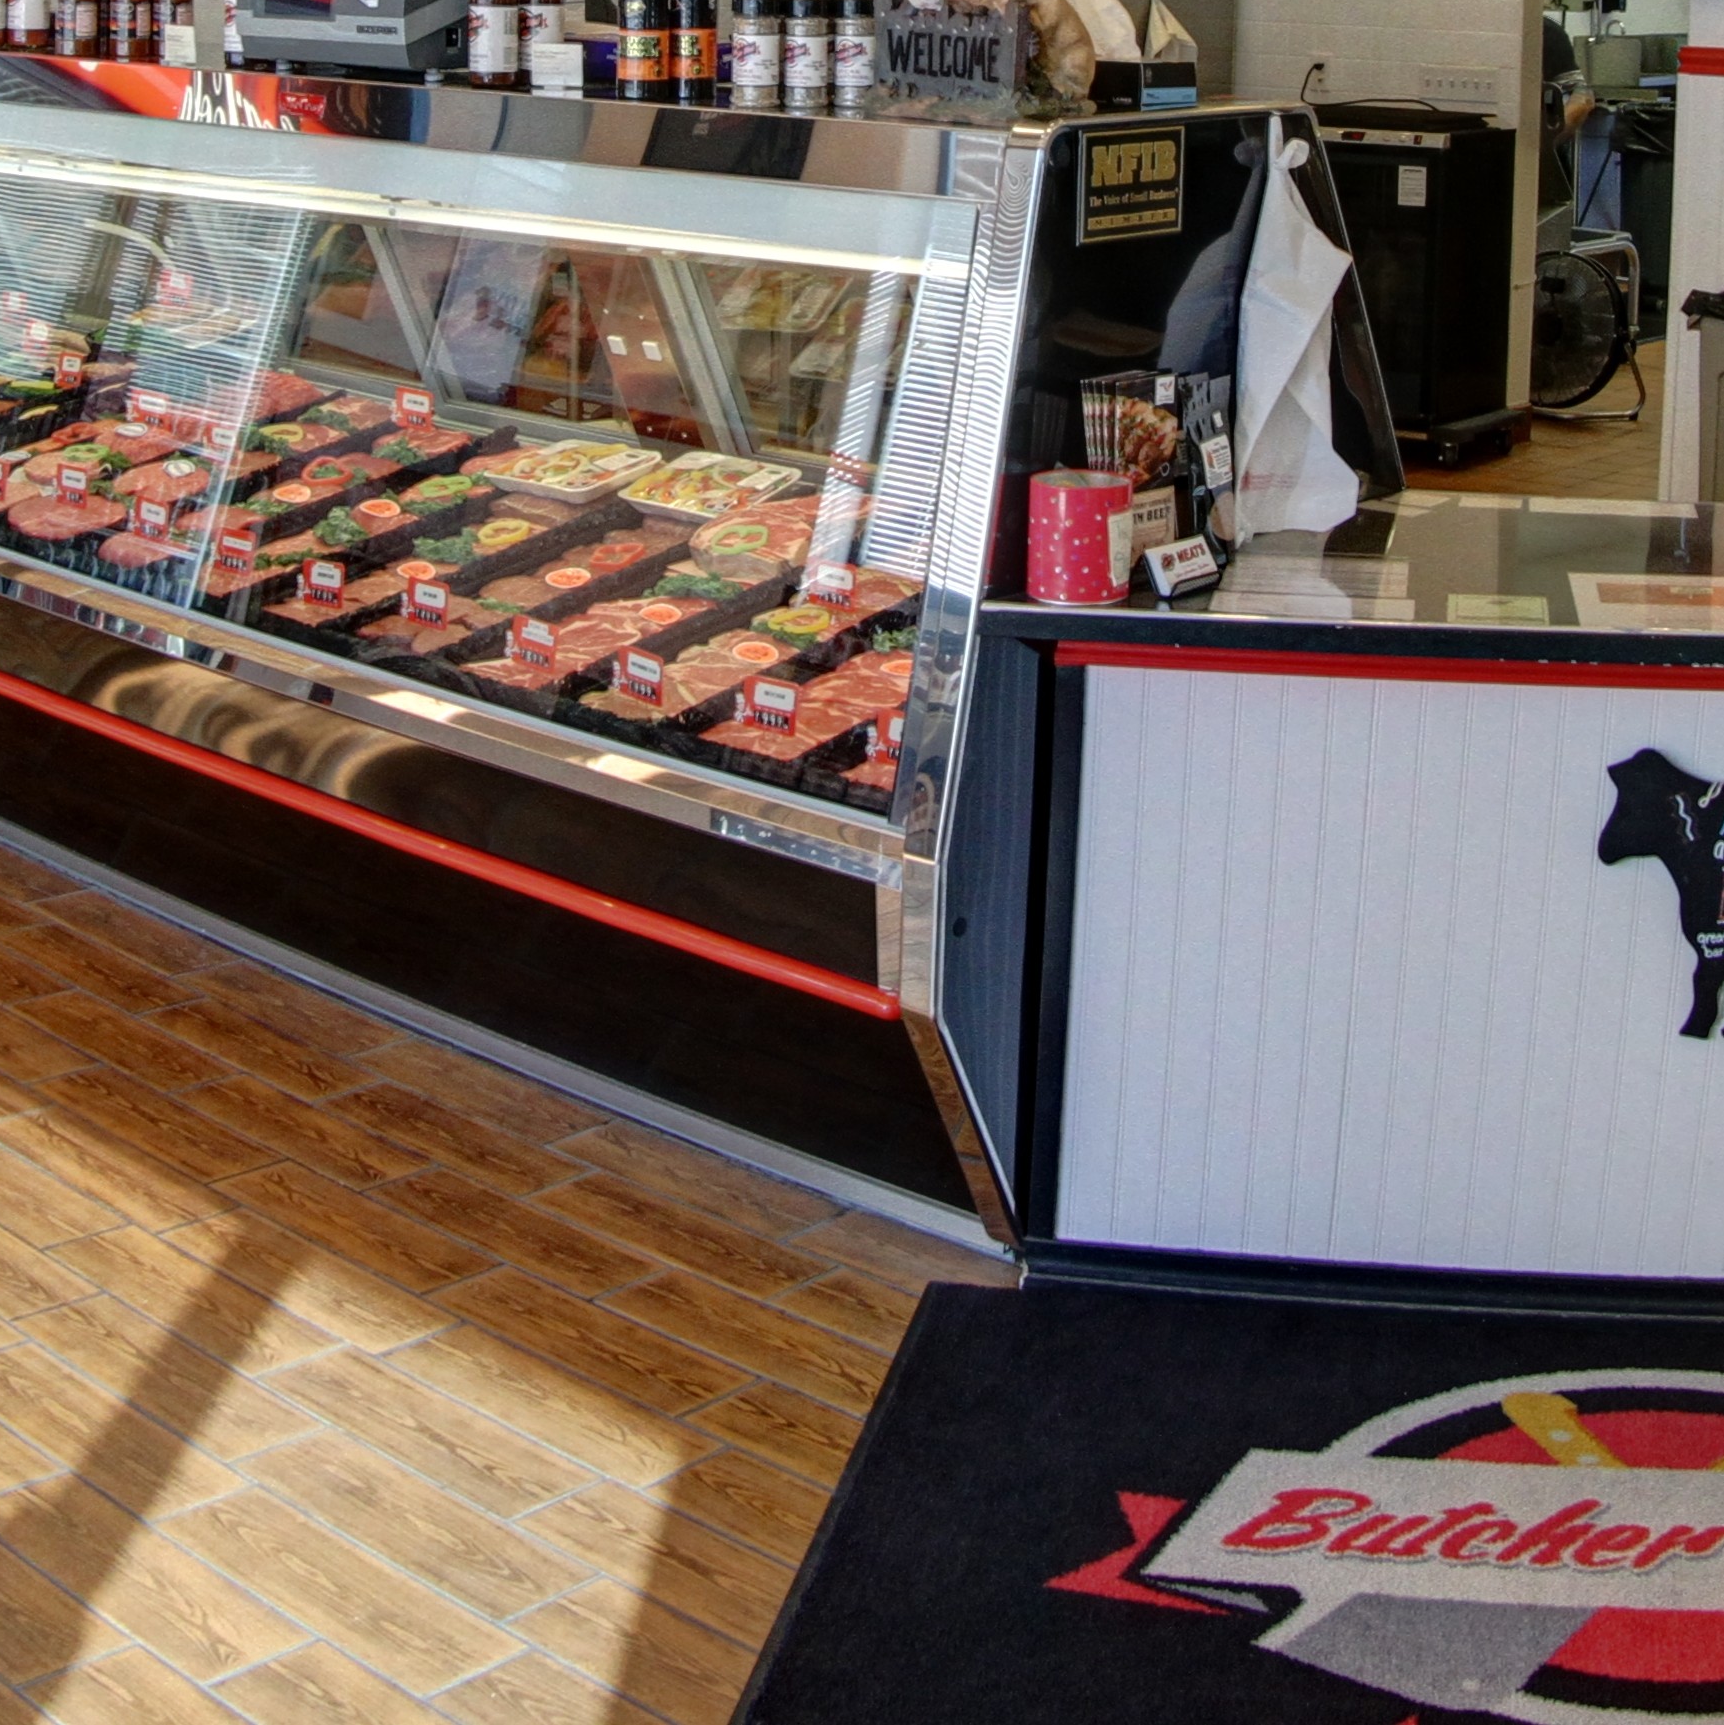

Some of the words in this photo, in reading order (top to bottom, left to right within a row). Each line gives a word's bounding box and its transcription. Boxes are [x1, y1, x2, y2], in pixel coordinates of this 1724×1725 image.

[887, 28, 1001, 83] WELCOME
[1091, 140, 1176, 187] NFIB
[1089, 196, 1102, 207] The
[1103, 194, 1120, 205] Voice
[1121, 193, 1129, 203] of
[1093, 212, 1170, 226] MEMBER
[1176, 543, 1206, 562] MEATS
